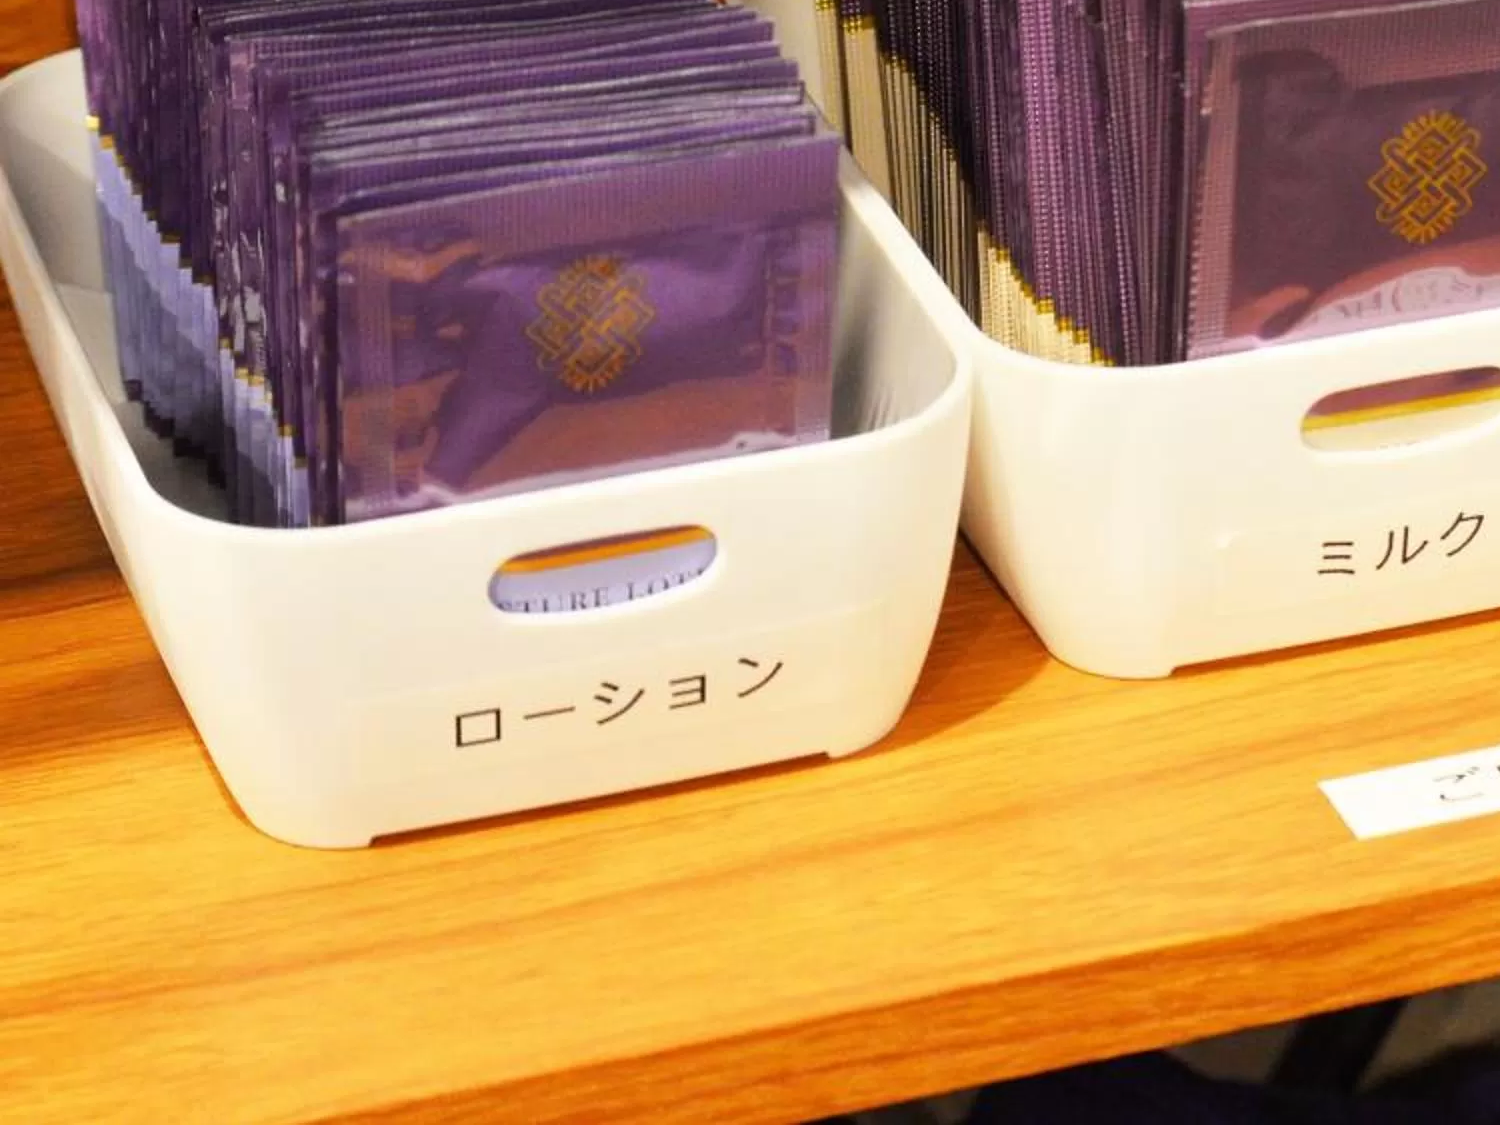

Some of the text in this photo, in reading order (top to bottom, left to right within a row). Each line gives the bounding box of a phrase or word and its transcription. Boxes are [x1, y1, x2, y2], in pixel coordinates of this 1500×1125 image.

[1317, 511, 1485, 575] ミルク
[455, 657, 784, 748] ローション
